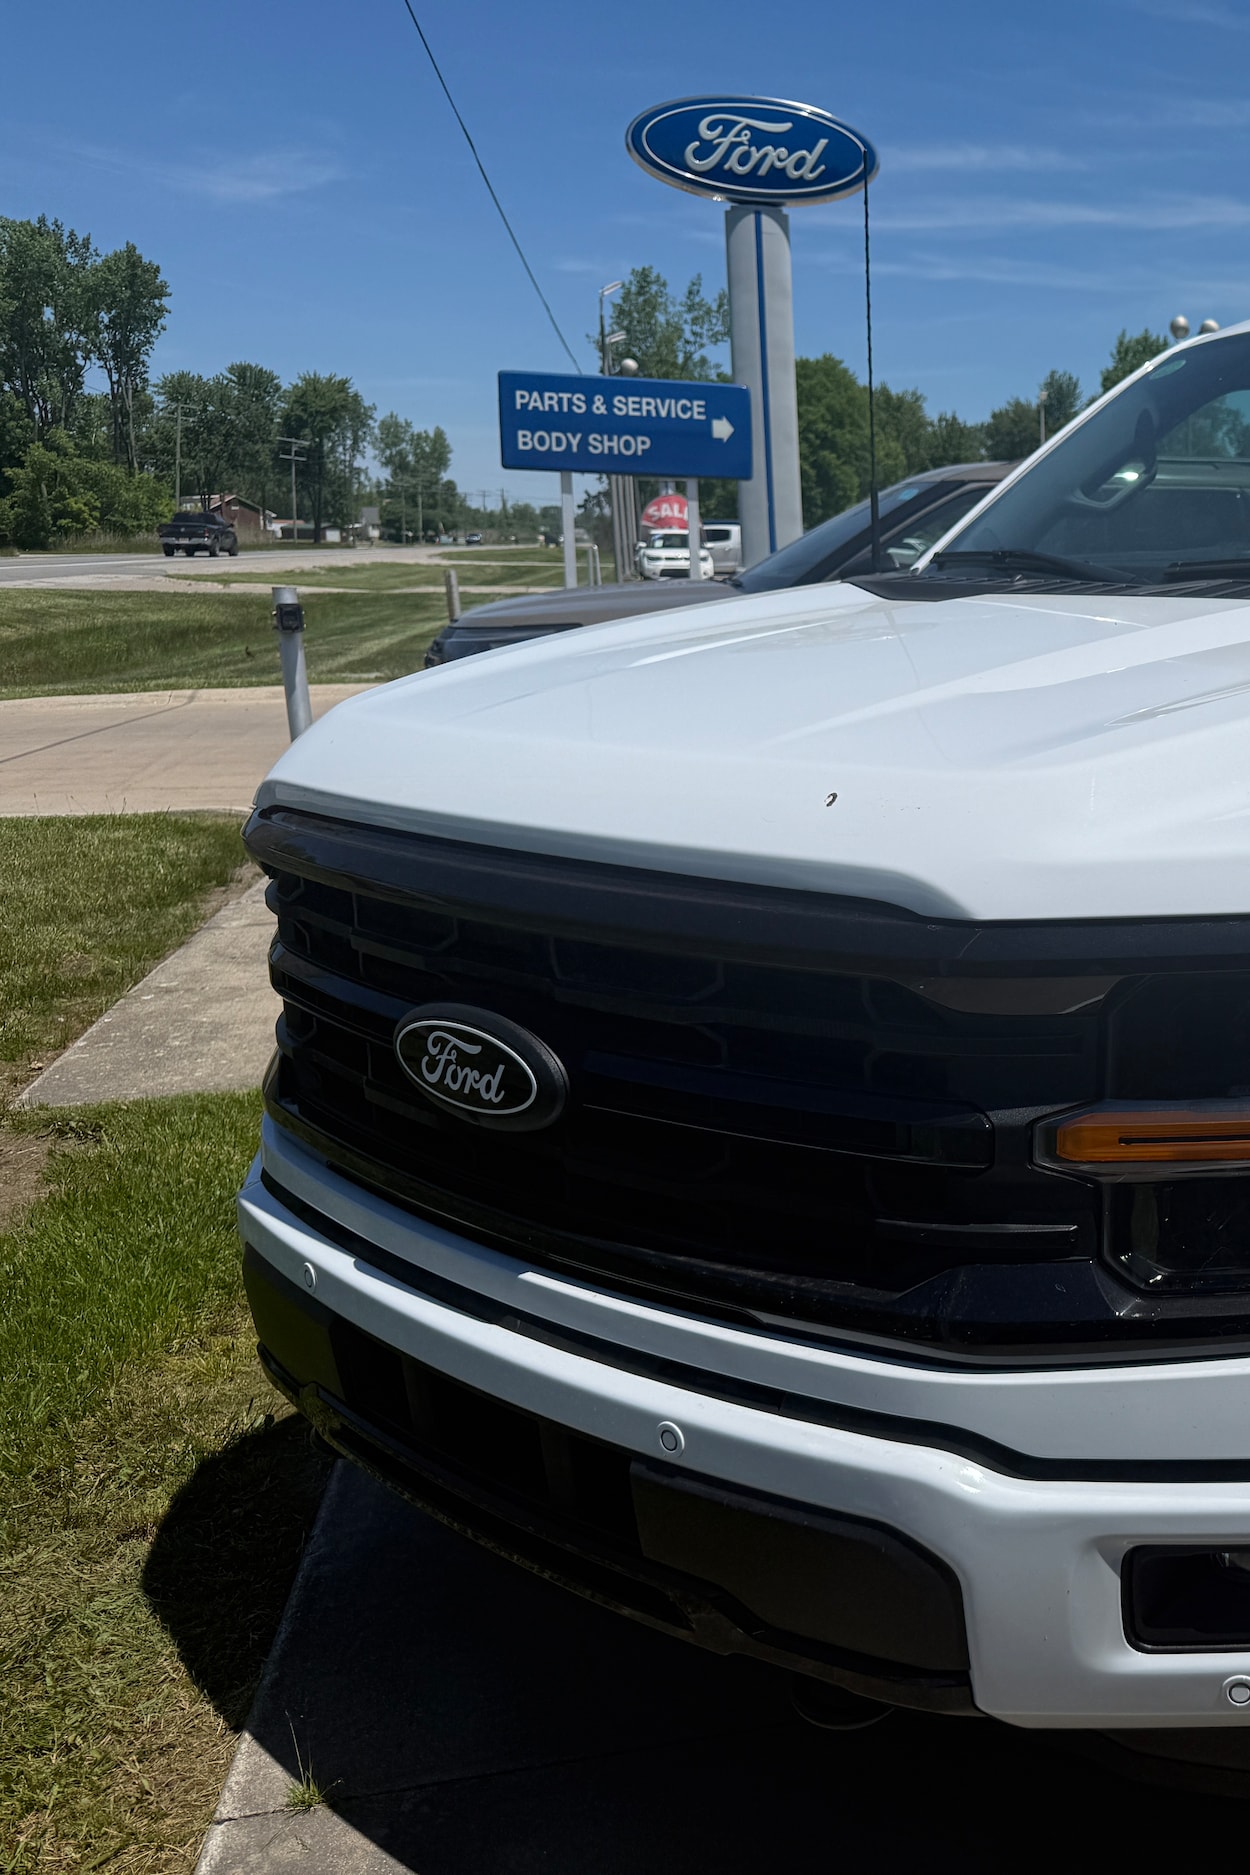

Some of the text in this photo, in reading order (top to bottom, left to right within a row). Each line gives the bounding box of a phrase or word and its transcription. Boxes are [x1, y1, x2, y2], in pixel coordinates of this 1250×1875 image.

[684, 114, 829, 181] Ford
[515, 390, 706, 420] PARTS & SERVICE
[517, 430, 651, 456] BODY SHOP
[421, 1031, 505, 1104] Ford
